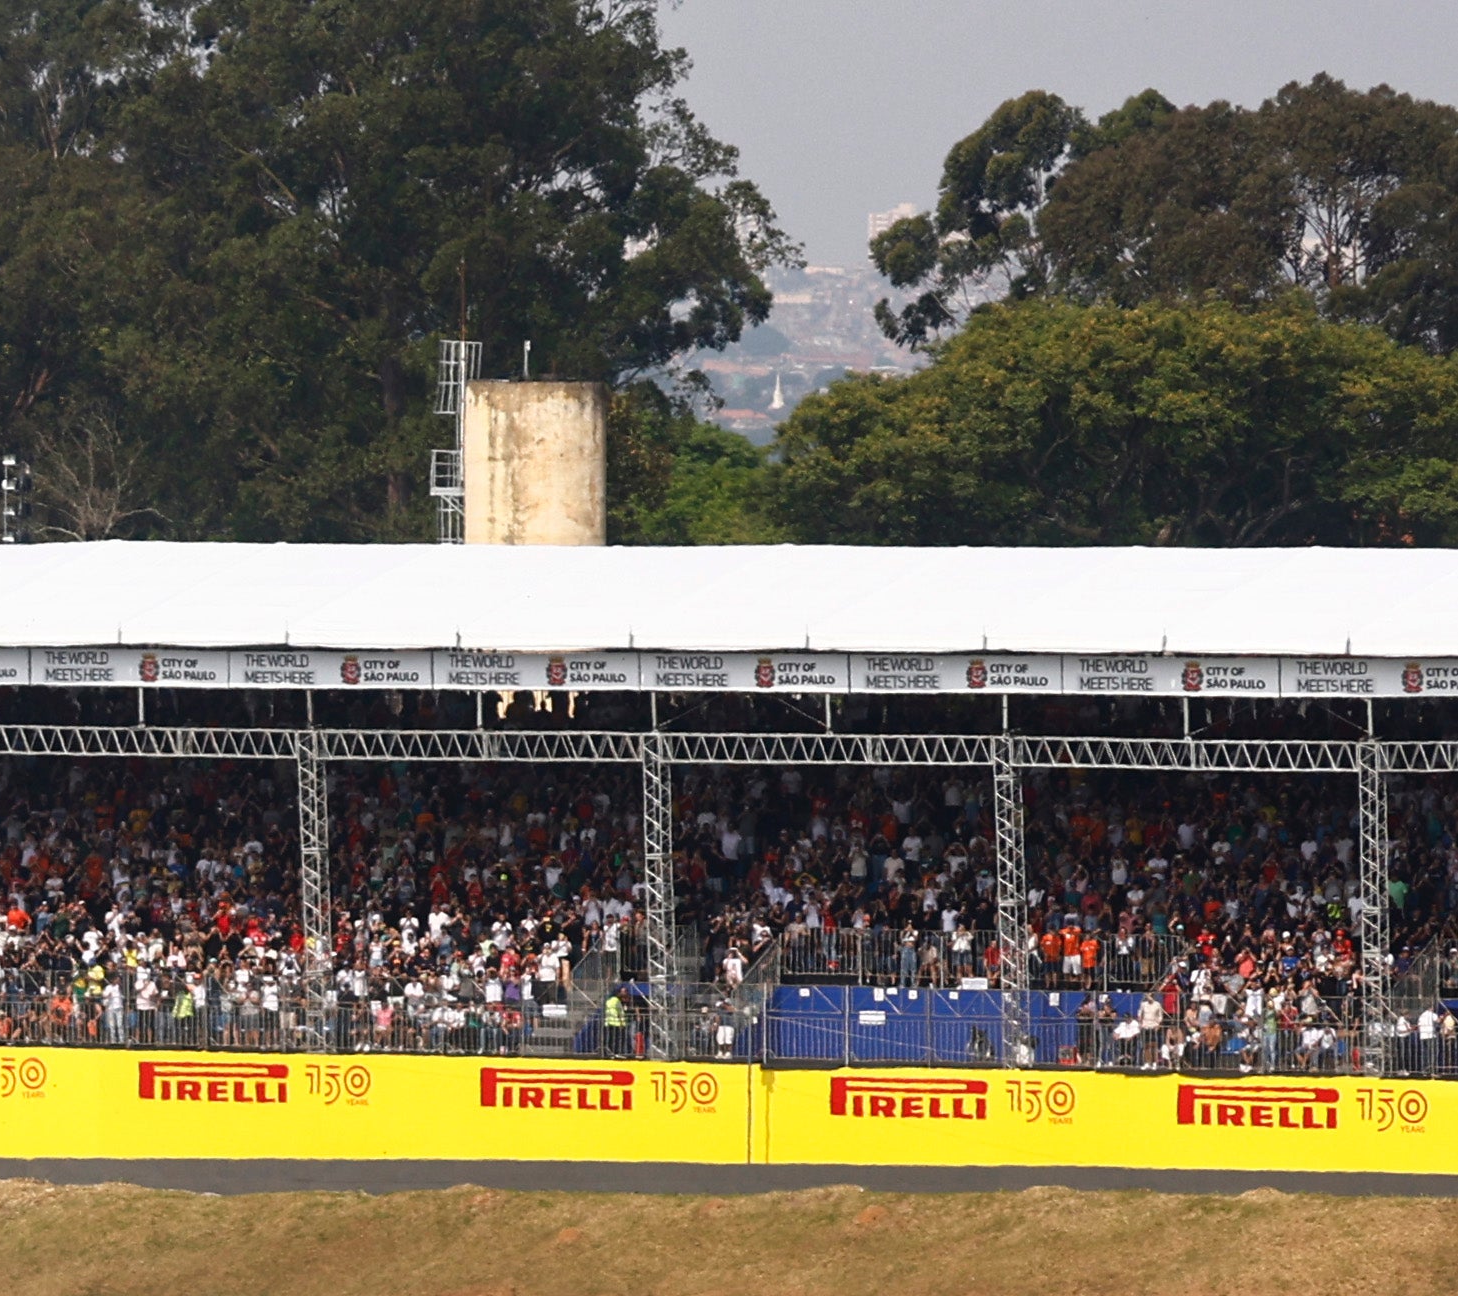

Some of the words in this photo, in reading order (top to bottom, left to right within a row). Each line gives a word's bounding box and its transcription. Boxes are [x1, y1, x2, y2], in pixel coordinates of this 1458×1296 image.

[656, 657, 678, 669] THE
[681, 657, 722, 670] WORLD
[778, 662, 800, 672] CITY
[803, 662, 816, 672] OF
[1080, 659, 1102, 672] THE
[1104, 659, 1148, 673] WORLD
[1206, 667, 1228, 676] CITY
[1231, 667, 1245, 676] OF
[656, 674, 694, 686] MEETS
[697, 674, 727, 687] HERE
[801, 675, 835, 685] PAULO
[1080, 677, 1119, 690] MEETS
[1121, 678, 1154, 690] HERE
[1230, 680, 1265, 689] PAULO
[140, 1062, 287, 1103] PIRELLI
[482, 1068, 633, 1111] PIRELLI
[831, 1078, 987, 1120] PIRELLI
[1178, 1086, 1339, 1129] PIRELLI
